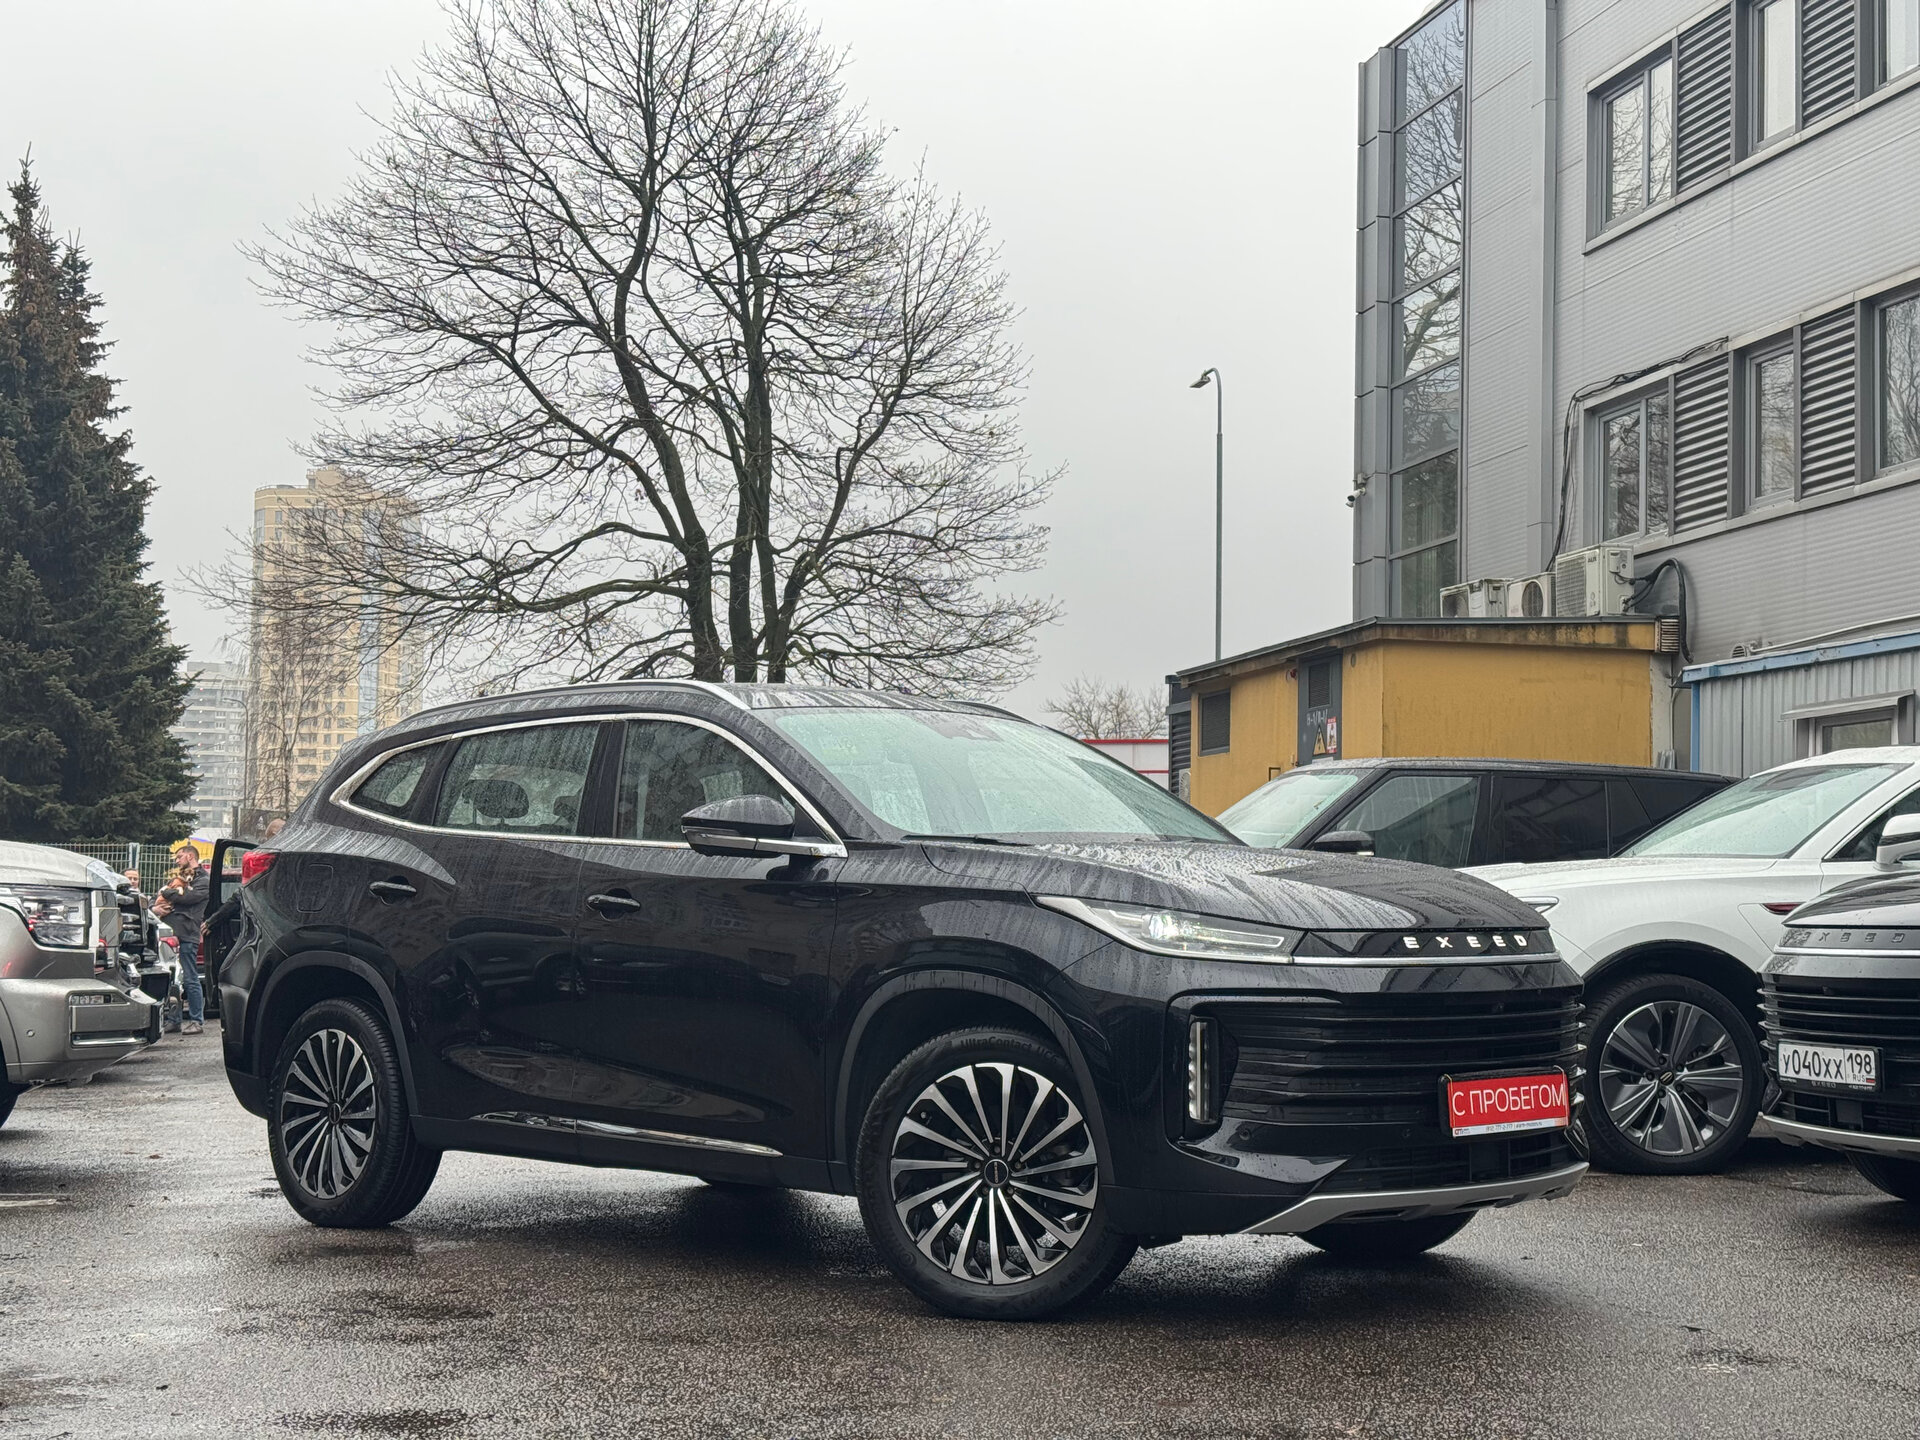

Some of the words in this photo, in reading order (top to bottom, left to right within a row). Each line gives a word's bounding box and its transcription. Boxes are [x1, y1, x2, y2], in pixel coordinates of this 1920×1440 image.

[1402, 934, 1528, 949] EXEED
[1783, 1049, 1844, 1080] У040ХХ
[1846, 1053, 1873, 1075] 198
[1852, 1073, 1866, 1083] RUS
[1452, 1091, 1467, 1116] С
[1469, 1083, 1566, 1115] ПРОБЕГОМ
